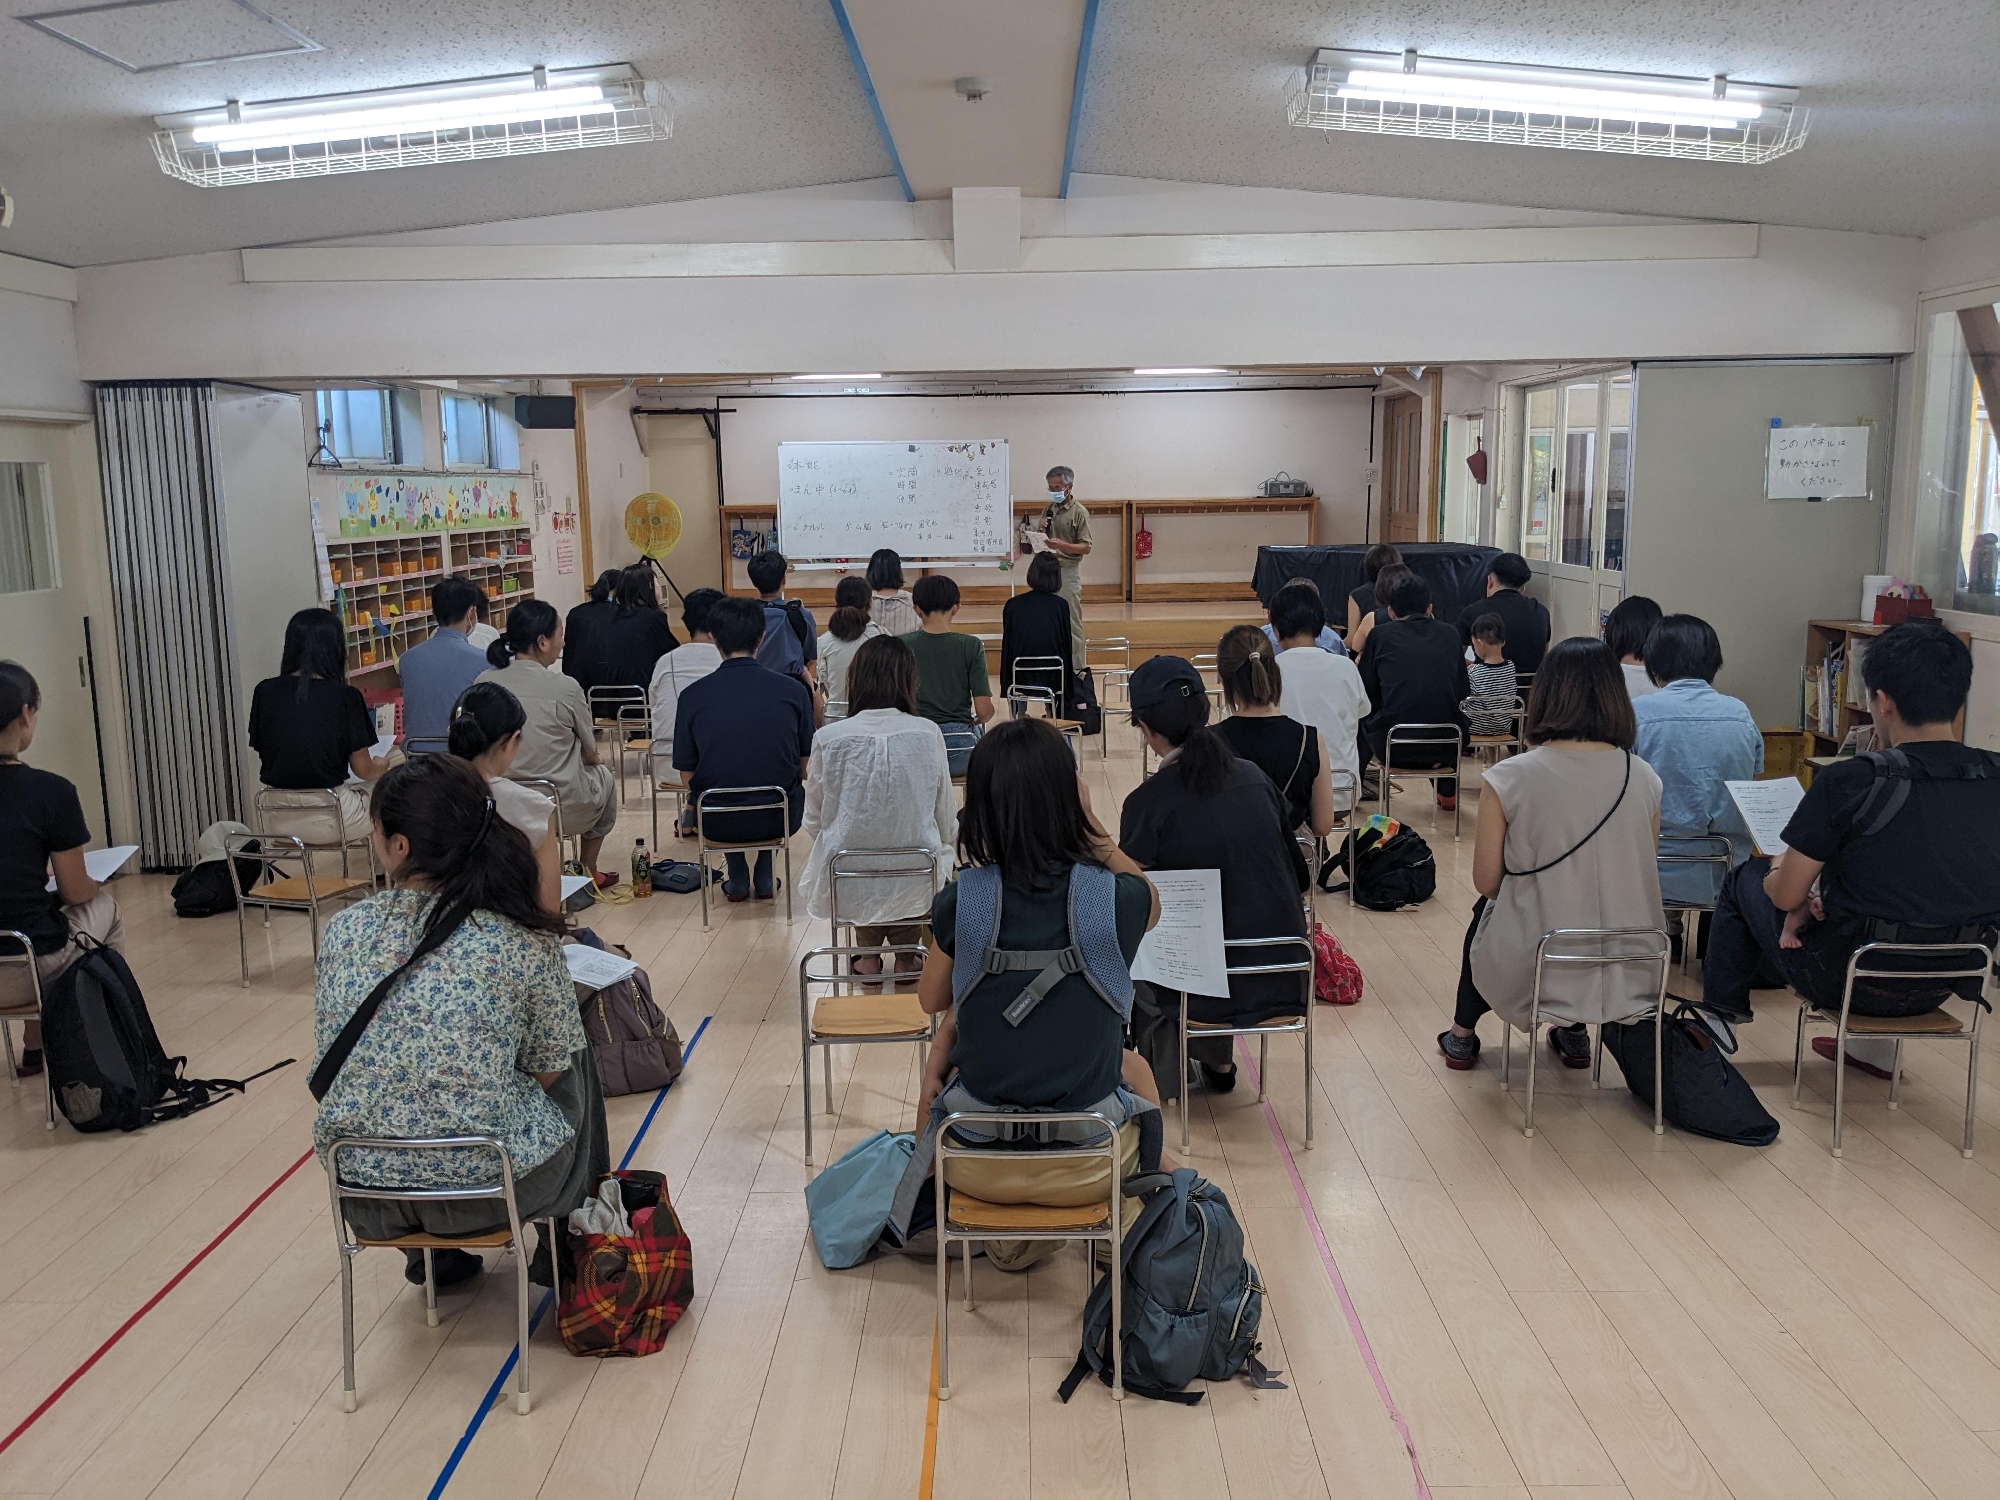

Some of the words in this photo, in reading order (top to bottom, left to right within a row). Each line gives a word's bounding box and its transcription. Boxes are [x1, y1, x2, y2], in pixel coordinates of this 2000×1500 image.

[1779, 437, 1847, 451] このパネルは
[1779, 458, 1842, 470] 動かさないで
[897, 467, 917, 477] 空間
[976, 466, 999, 476] 楽しい
[897, 480, 917, 490] 時間
[897, 493, 917, 504] 仲間
